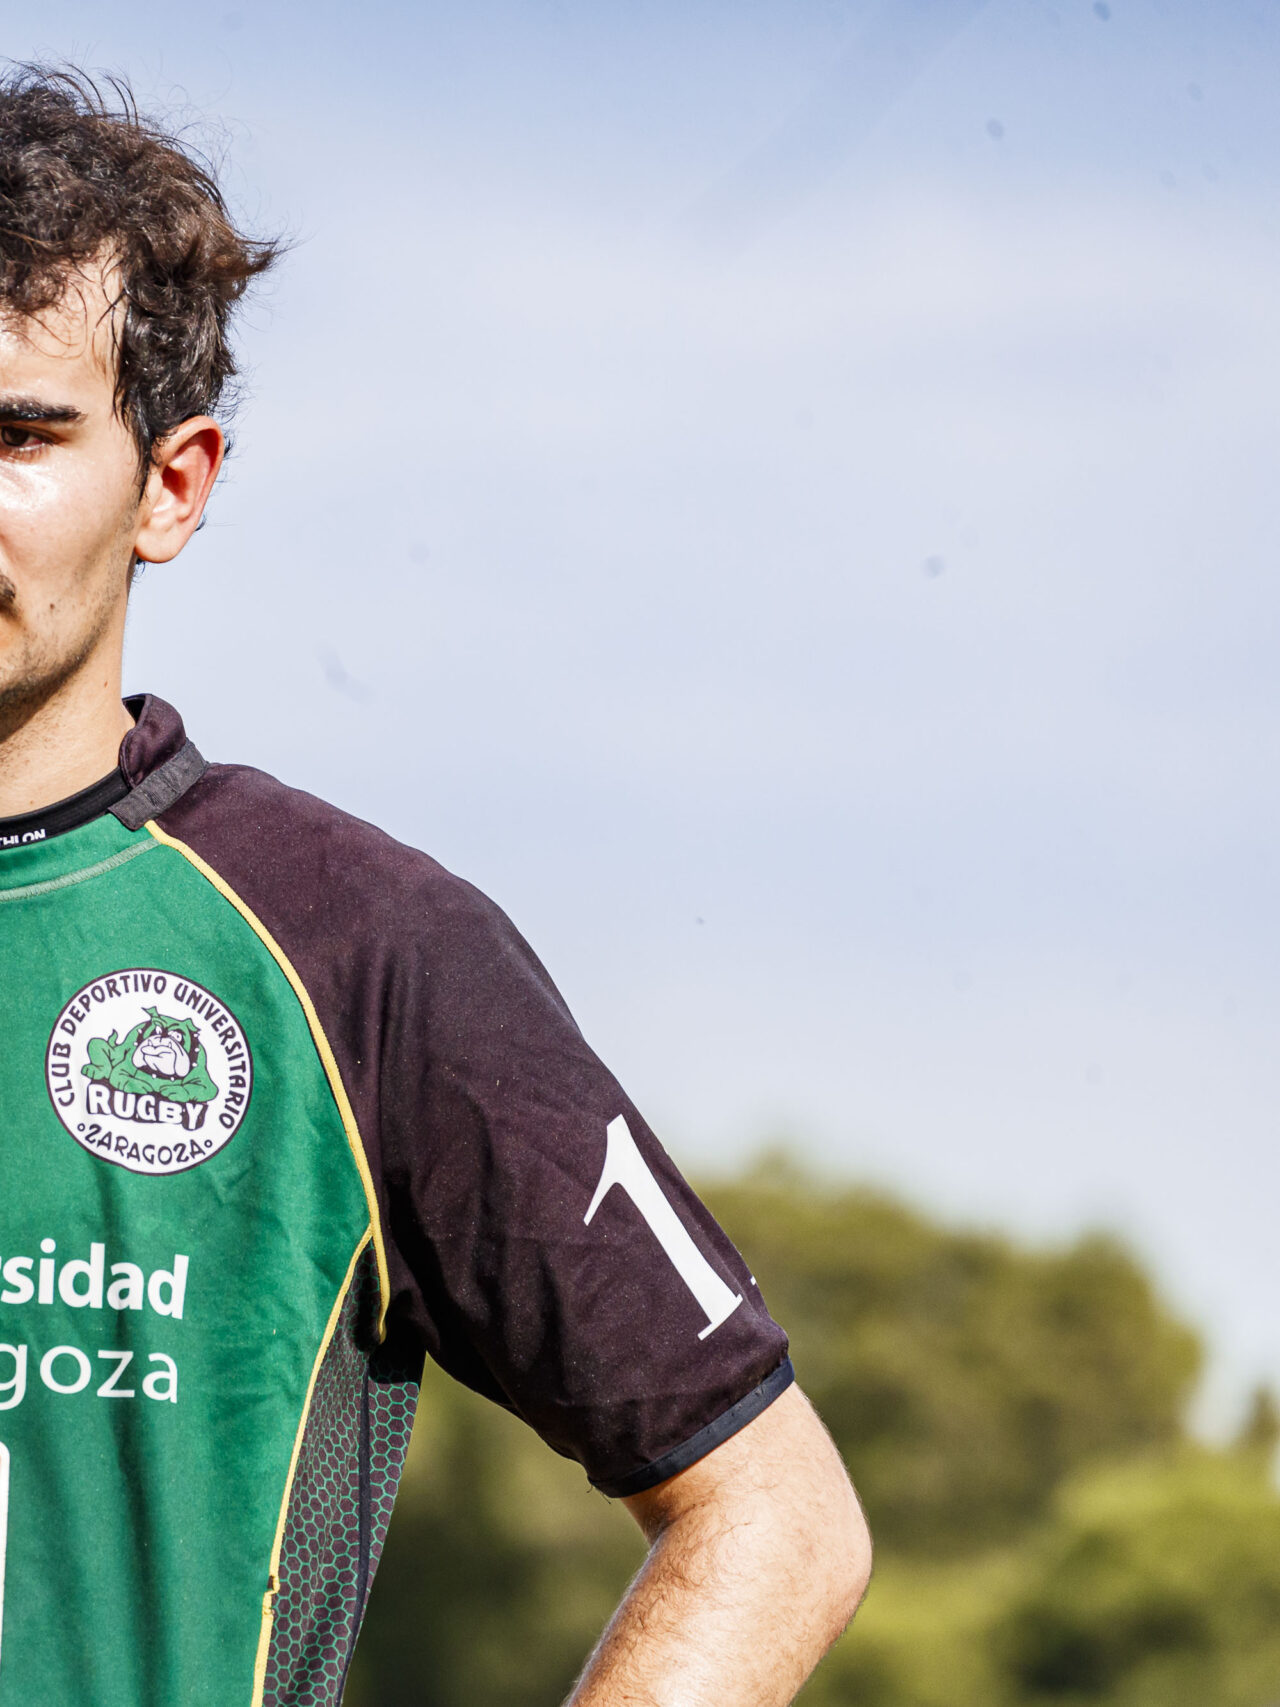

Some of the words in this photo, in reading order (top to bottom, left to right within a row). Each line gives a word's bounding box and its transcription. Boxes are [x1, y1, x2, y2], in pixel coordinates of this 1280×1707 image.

[61, 974, 167, 1036] DEPORTIVO
[52, 1041, 75, 1107] CLUB
[174, 983, 247, 1129] UNIVERSITARIO
[87, 1083, 208, 1131] RUGBY
[584, 1114, 756, 1340] 1
